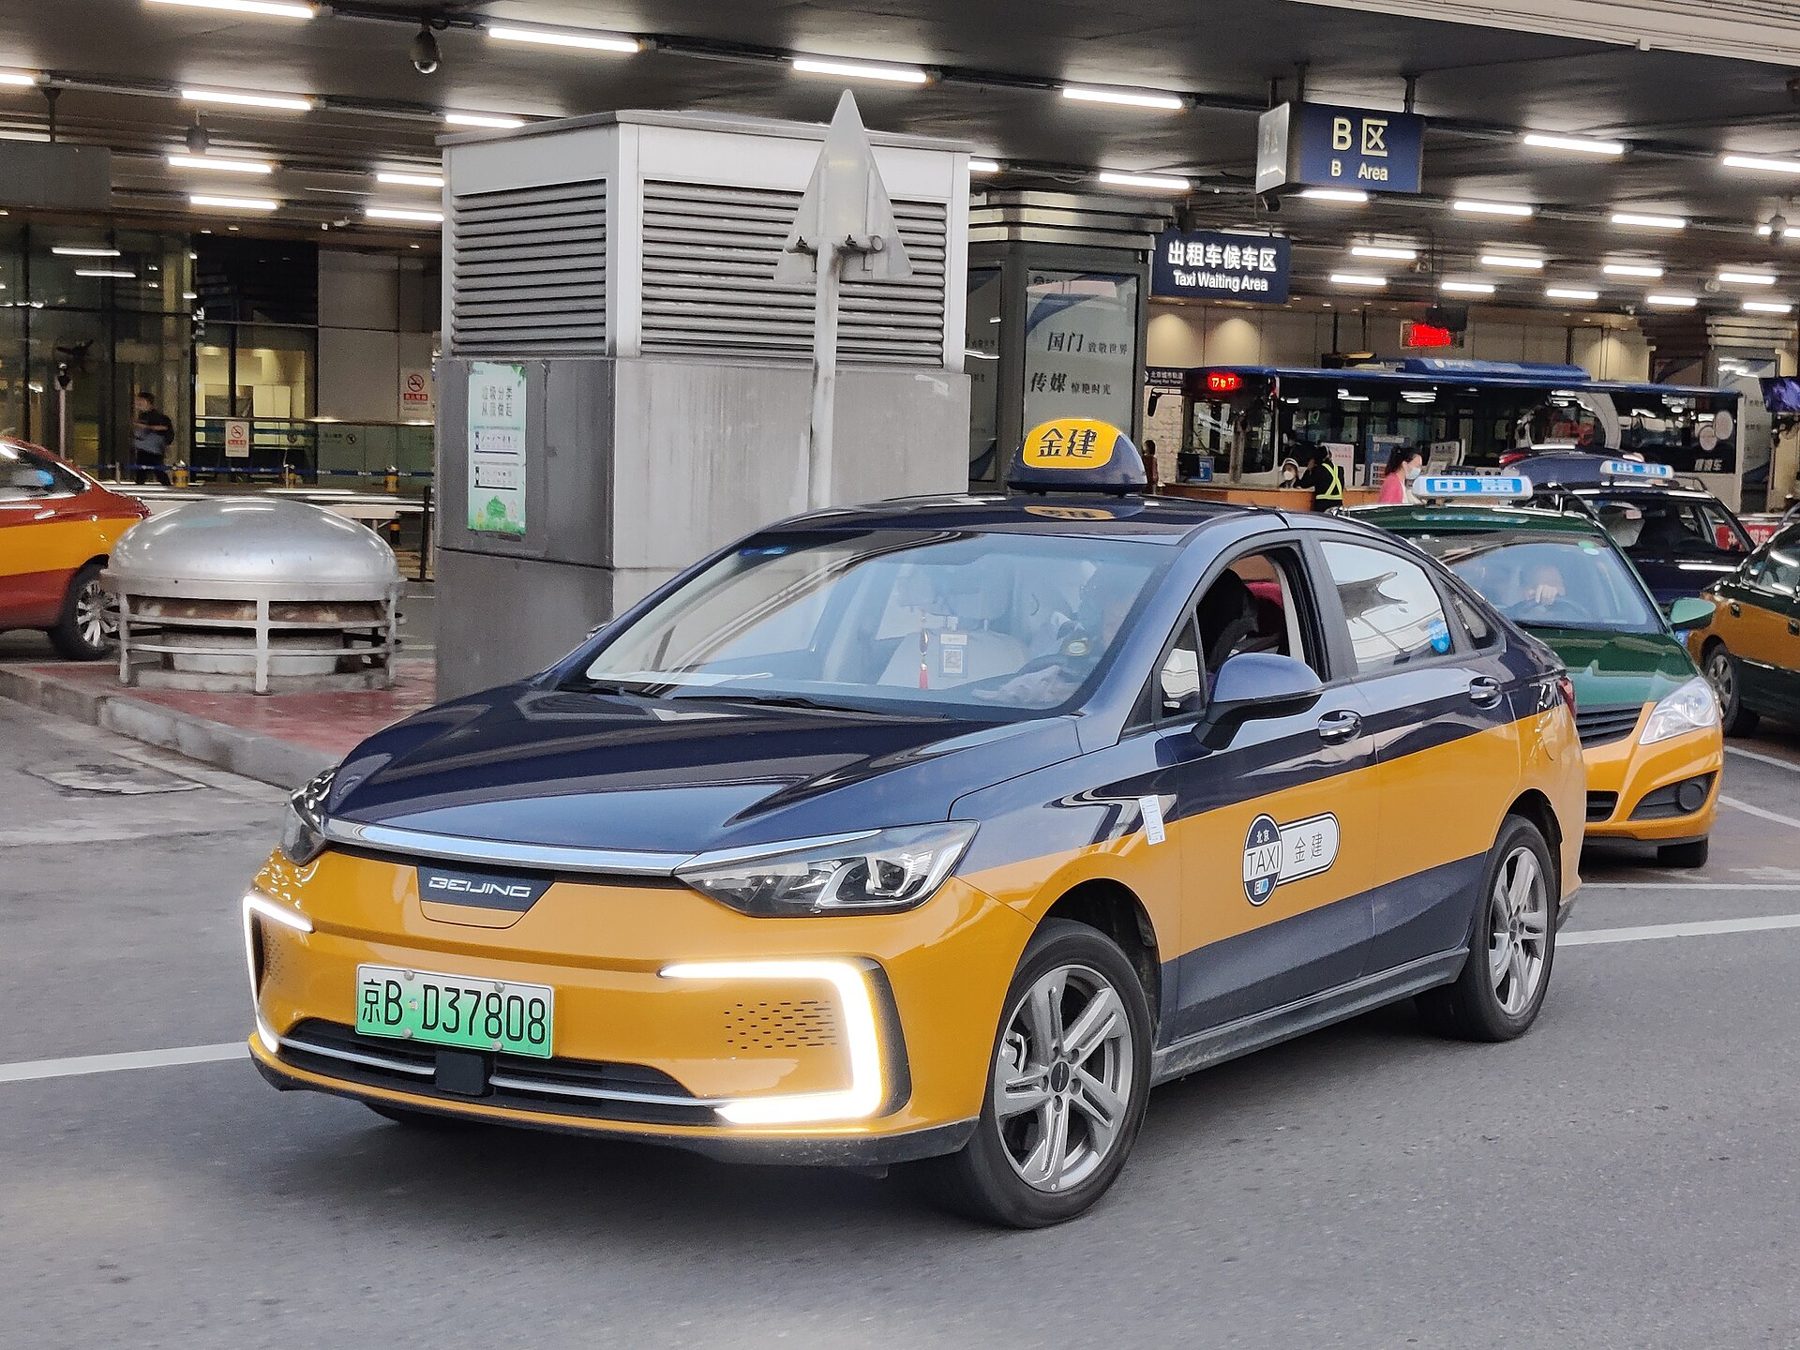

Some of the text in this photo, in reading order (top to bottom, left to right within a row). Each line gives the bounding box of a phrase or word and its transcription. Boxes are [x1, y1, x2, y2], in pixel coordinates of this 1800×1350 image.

[1332, 117, 1388, 157] B区
[1331, 159, 1388, 181] B Area
[1167, 240, 1276, 272] 出租车候车区
[1173, 269, 1268, 292] Taxi Waiting Area
[1047, 331, 1084, 352] 国门
[1031, 372, 1067, 392] 传媒
[1037, 428, 1097, 458] 金建
[1256, 829, 1270, 843] 北京
[1294, 832, 1323, 864] 金建
[1247, 844, 1280, 876] TAXI
[428, 876, 531, 898] BEIJING
[422, 984, 546, 1045] D37808
